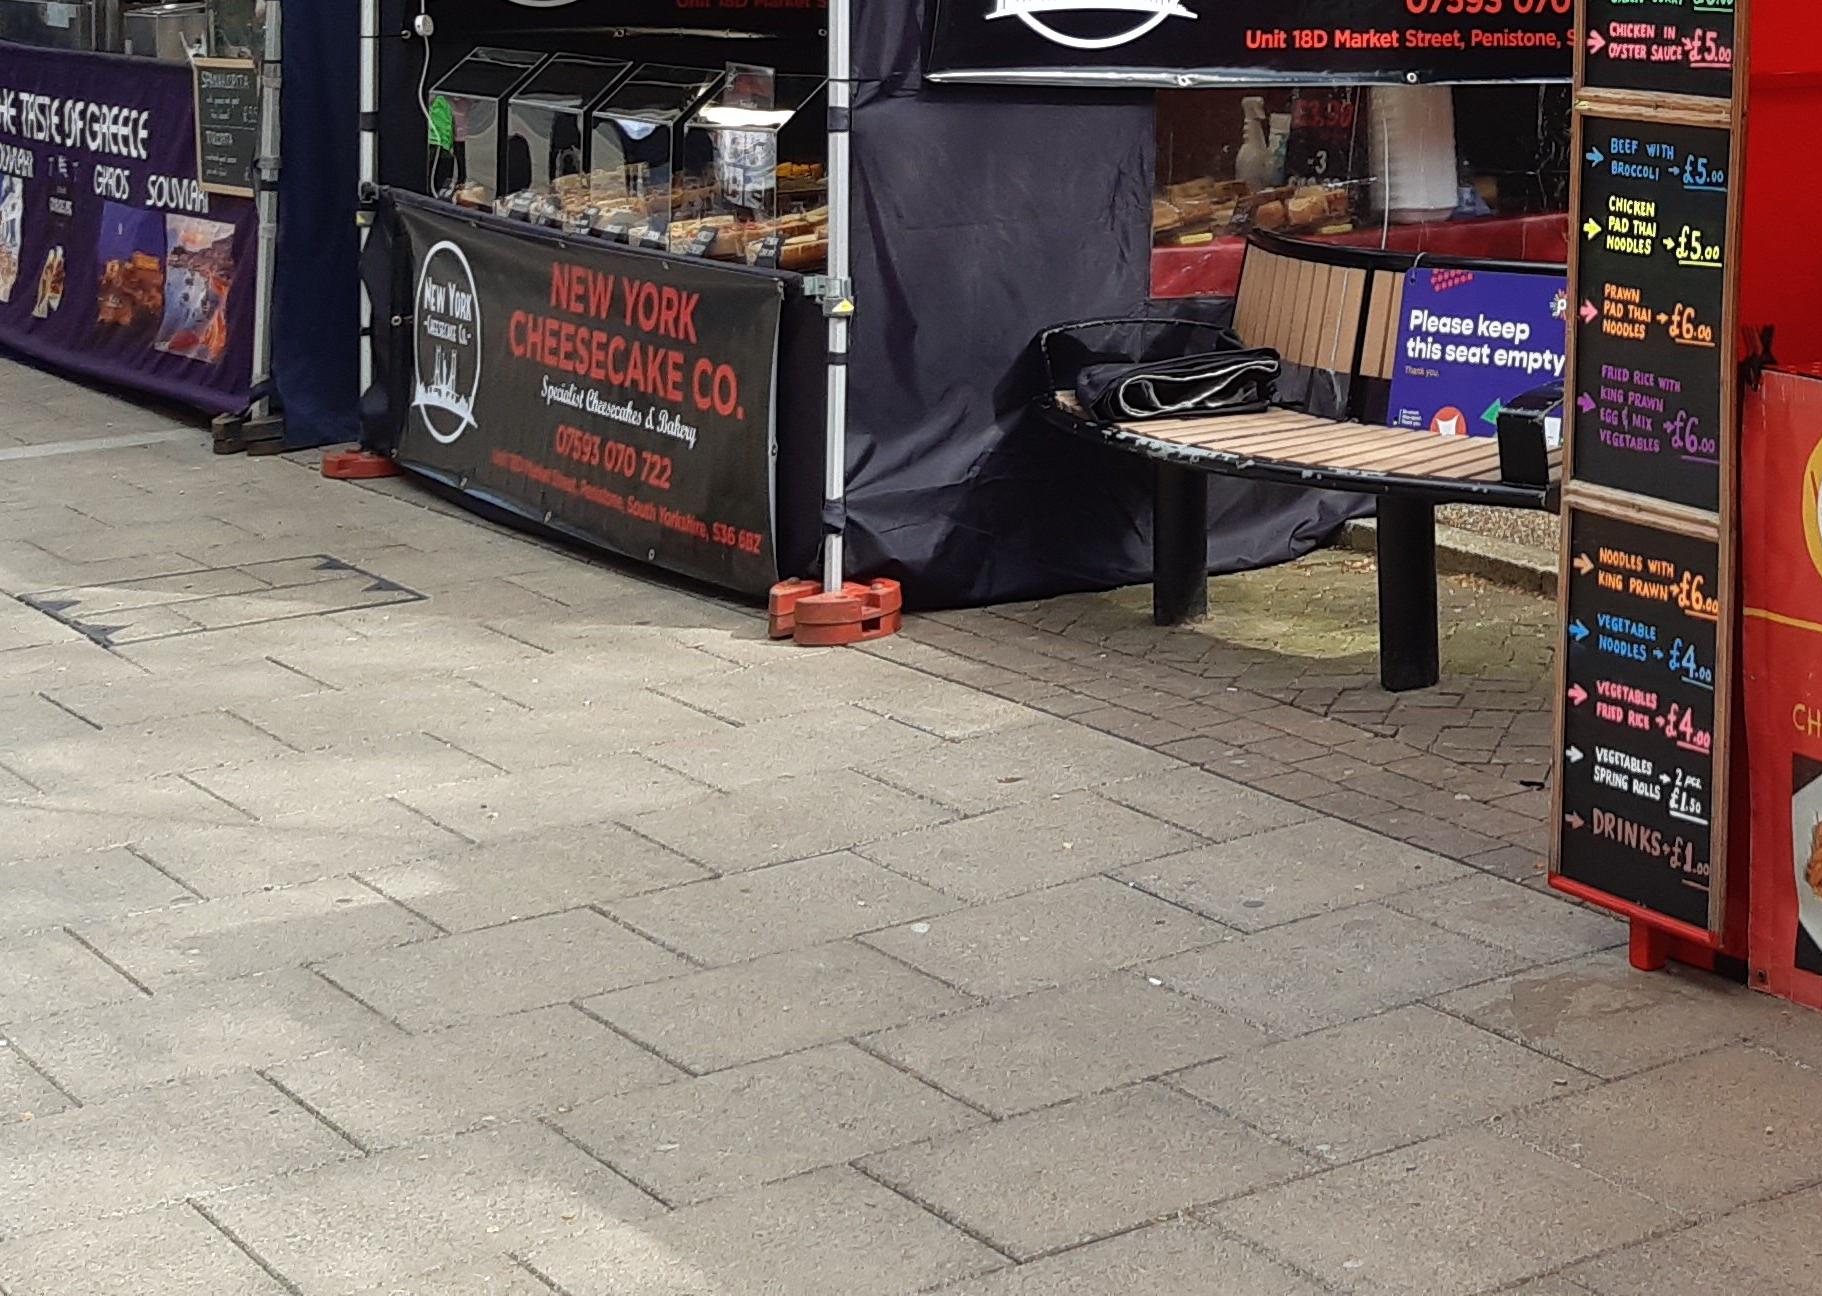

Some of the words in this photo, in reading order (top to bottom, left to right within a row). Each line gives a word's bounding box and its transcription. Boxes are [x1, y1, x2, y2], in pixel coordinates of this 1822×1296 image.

[1246, 29, 1287, 49] Unit
[1292, 30, 1328, 49] 18D
[1334, 29, 1399, 48] Market
[1405, 29, 1465, 51] Street,
[1471, 29, 1561, 50] Penistone,
[19, 91, 62, 145] TASTE
[64, 98, 86, 148] OF
[86, 102, 150, 160] GREECE
[1610, 138, 1639, 155] BEEF
[1646, 143, 1675, 160] WITH
[94, 164, 130, 200] GYROS
[1611, 160, 1660, 181] BROCCOLI
[1682, 154, 1724, 184] £5.00
[1608, 195, 1655, 217] CHICKEN
[1606, 234, 1651, 255] NOODLES
[1675, 225, 1720, 260] £5.00
[1608, 216, 1629, 233] PAD
[1633, 220, 1657, 238] THAI
[551, 261, 614, 321] NEW
[622, 275, 699, 344] YORK
[1409, 308, 1474, 337] Please
[1477, 313, 1530, 345] keep
[509, 309, 686, 403] CHEESECAKE
[692, 357, 744, 420] CO.
[1406, 336, 1442, 361] this
[1445, 343, 1490, 365] seat
[1494, 348, 1566, 377] empty
[541, 374, 584, 410] Specialist
[586, 388, 642, 425] Cheesecakes
[657, 409, 697, 449] Bakery
[556, 423, 600, 466] 07593
[604, 440, 636, 478] 070
[641, 450, 673, 490] 722
[712, 521, 736, 547] S36
[1597, 613, 1657, 641] VEGETABLE
[1598, 634, 1647, 662] NOODLES
[1668, 637, 1712, 682] £4.00
[1596, 680, 1658, 709] VEGETABLES
[1596, 702, 1623, 722] FRIED
[1628, 709, 1650, 730] RICE
[1664, 703, 1710, 746] £4.00
[1592, 807, 1662, 857] DRINKS
[1669, 836, 1709, 876] £1.00
